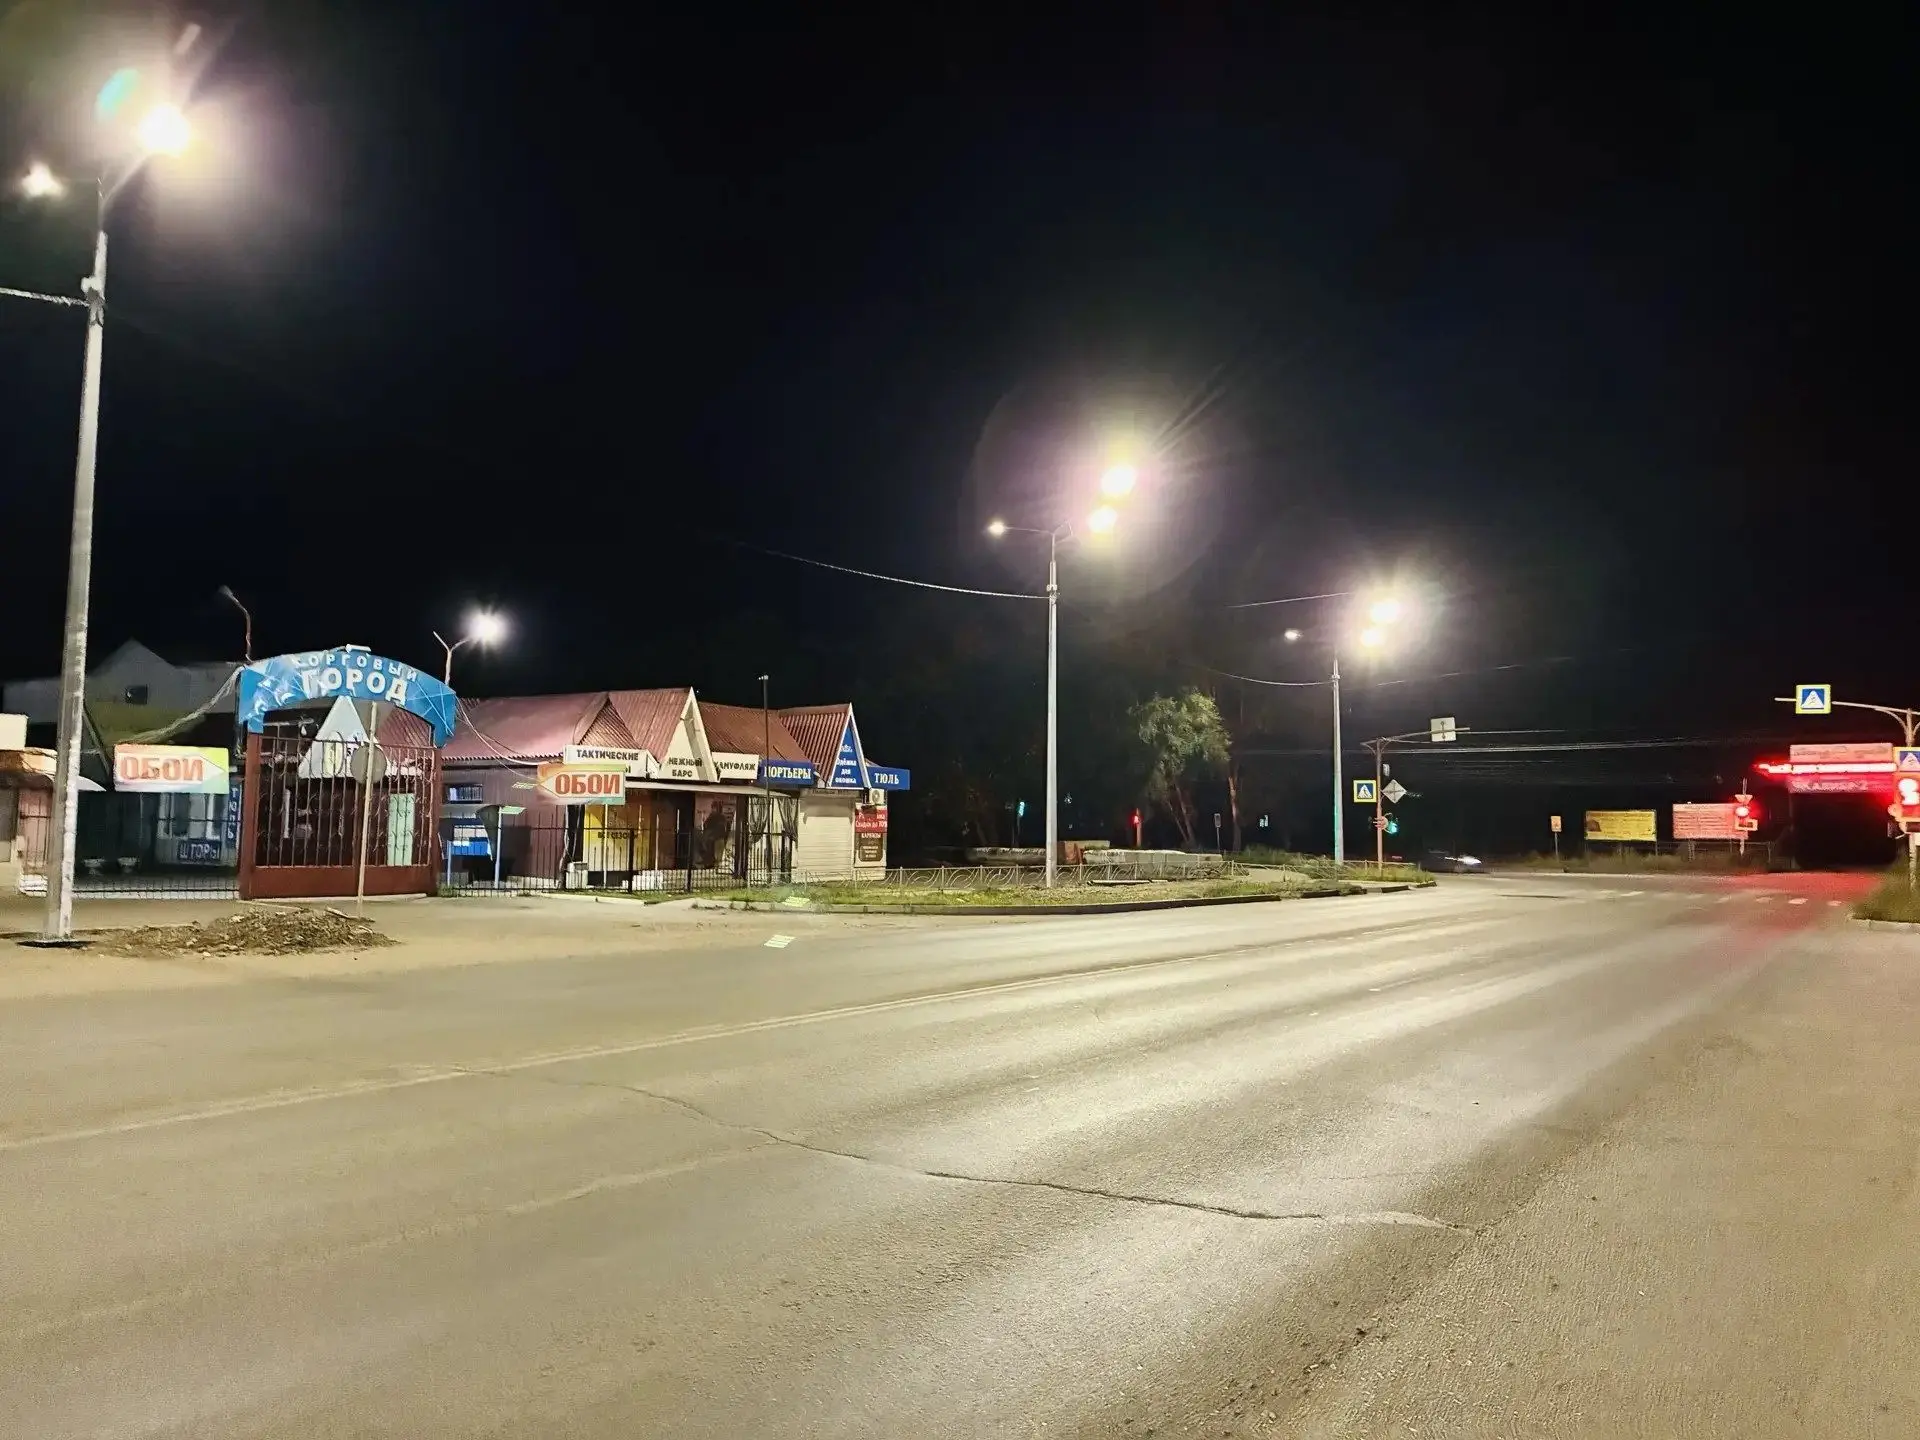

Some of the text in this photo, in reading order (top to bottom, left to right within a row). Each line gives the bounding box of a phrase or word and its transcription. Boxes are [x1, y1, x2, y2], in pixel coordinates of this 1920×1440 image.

[302, 666, 408, 708] ГОРОД
[576, 749, 639, 761] ТАКТИЧЕСКИЕ
[120, 757, 204, 780] ОБОИ
[672, 769, 693, 778] БАРС
[764, 766, 812, 780] ПОРТЬЕРЫ
[555, 773, 621, 795] ОБОИ
[874, 772, 900, 785] ТЮЛЬ
